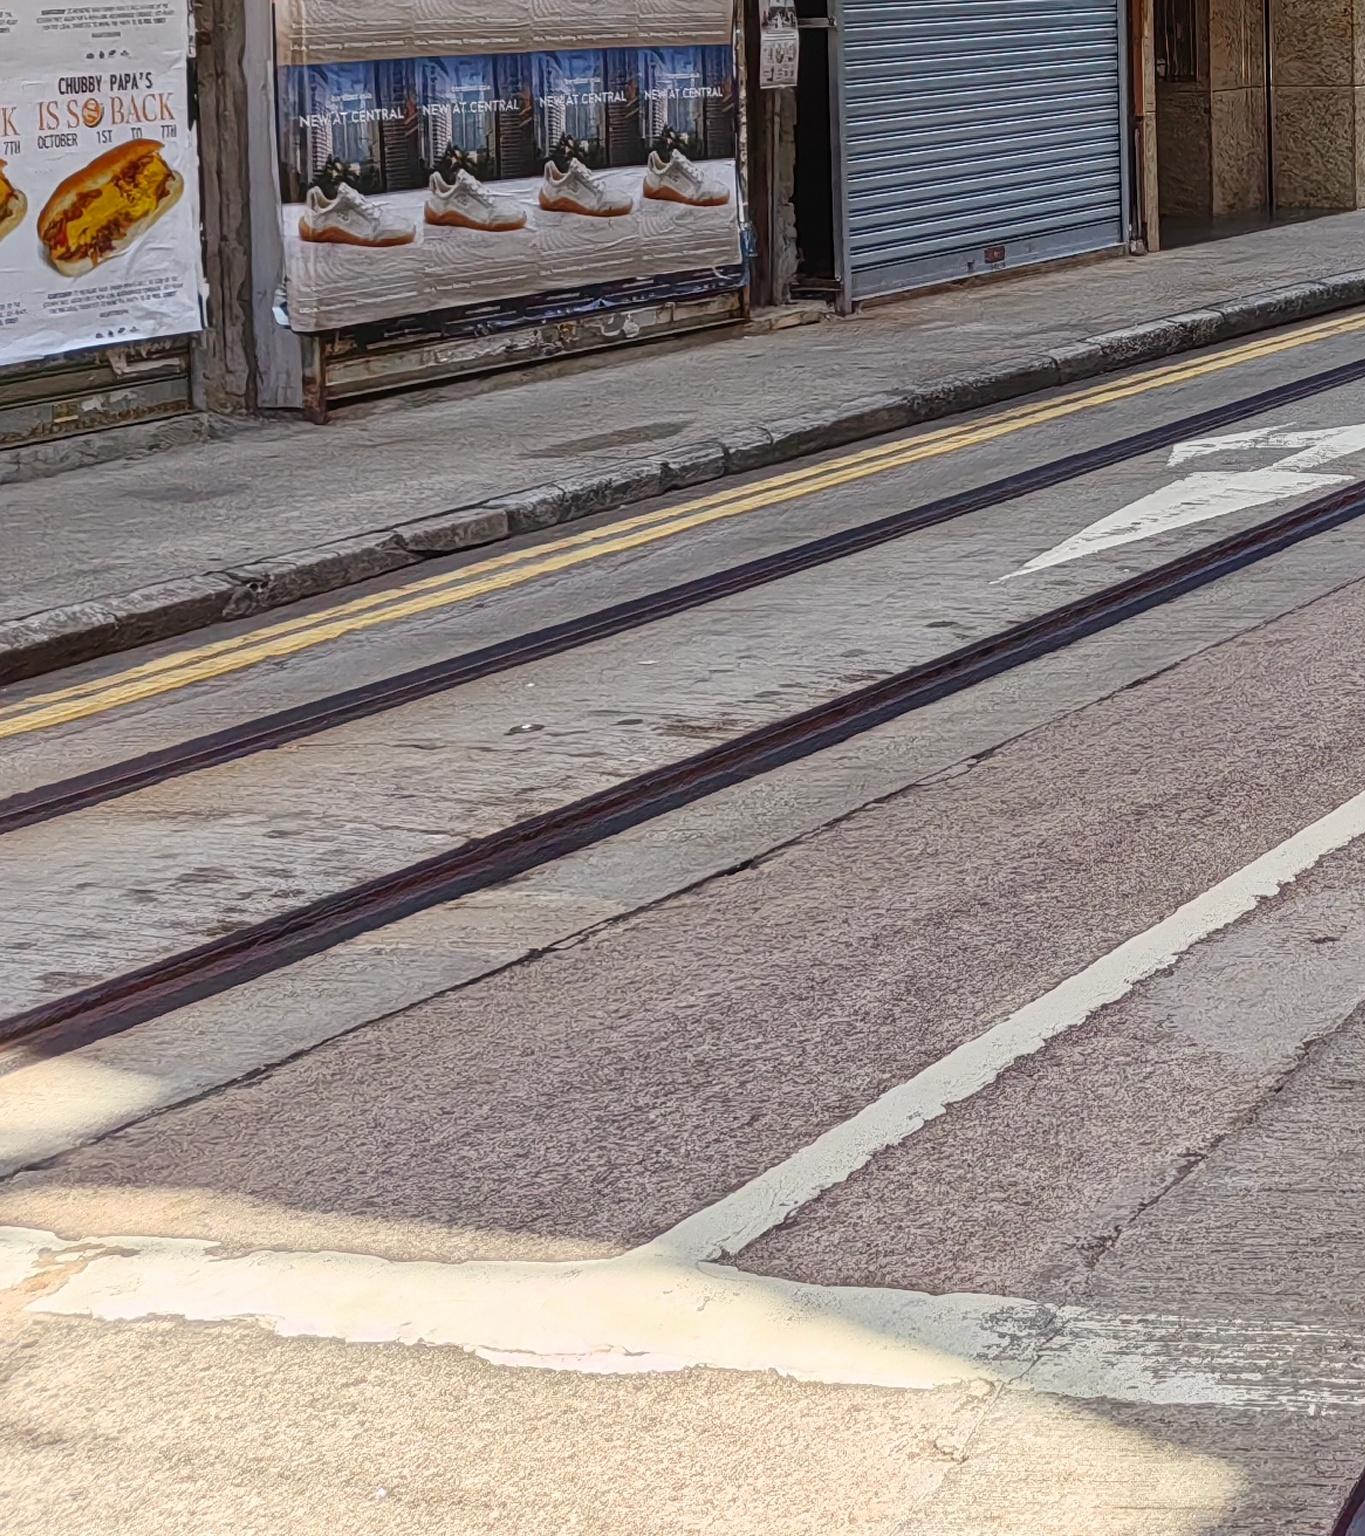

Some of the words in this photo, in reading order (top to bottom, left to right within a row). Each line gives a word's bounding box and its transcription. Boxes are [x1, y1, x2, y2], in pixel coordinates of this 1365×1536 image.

[58, 75, 102, 95] CHUBBY
[110, 72, 153, 91] PAPA'S
[581, 91, 627, 105] CENTRAL
[682, 86, 723, 99] CENTRAL
[37, 100, 60, 131] IS
[111, 92, 176, 125] BACK
[470, 99, 519, 114] CENTRAL
[351, 108, 404, 122] CENTRAL
[37, 135, 78, 149] OCTOBER
[97, 129, 113, 144] 1ST
